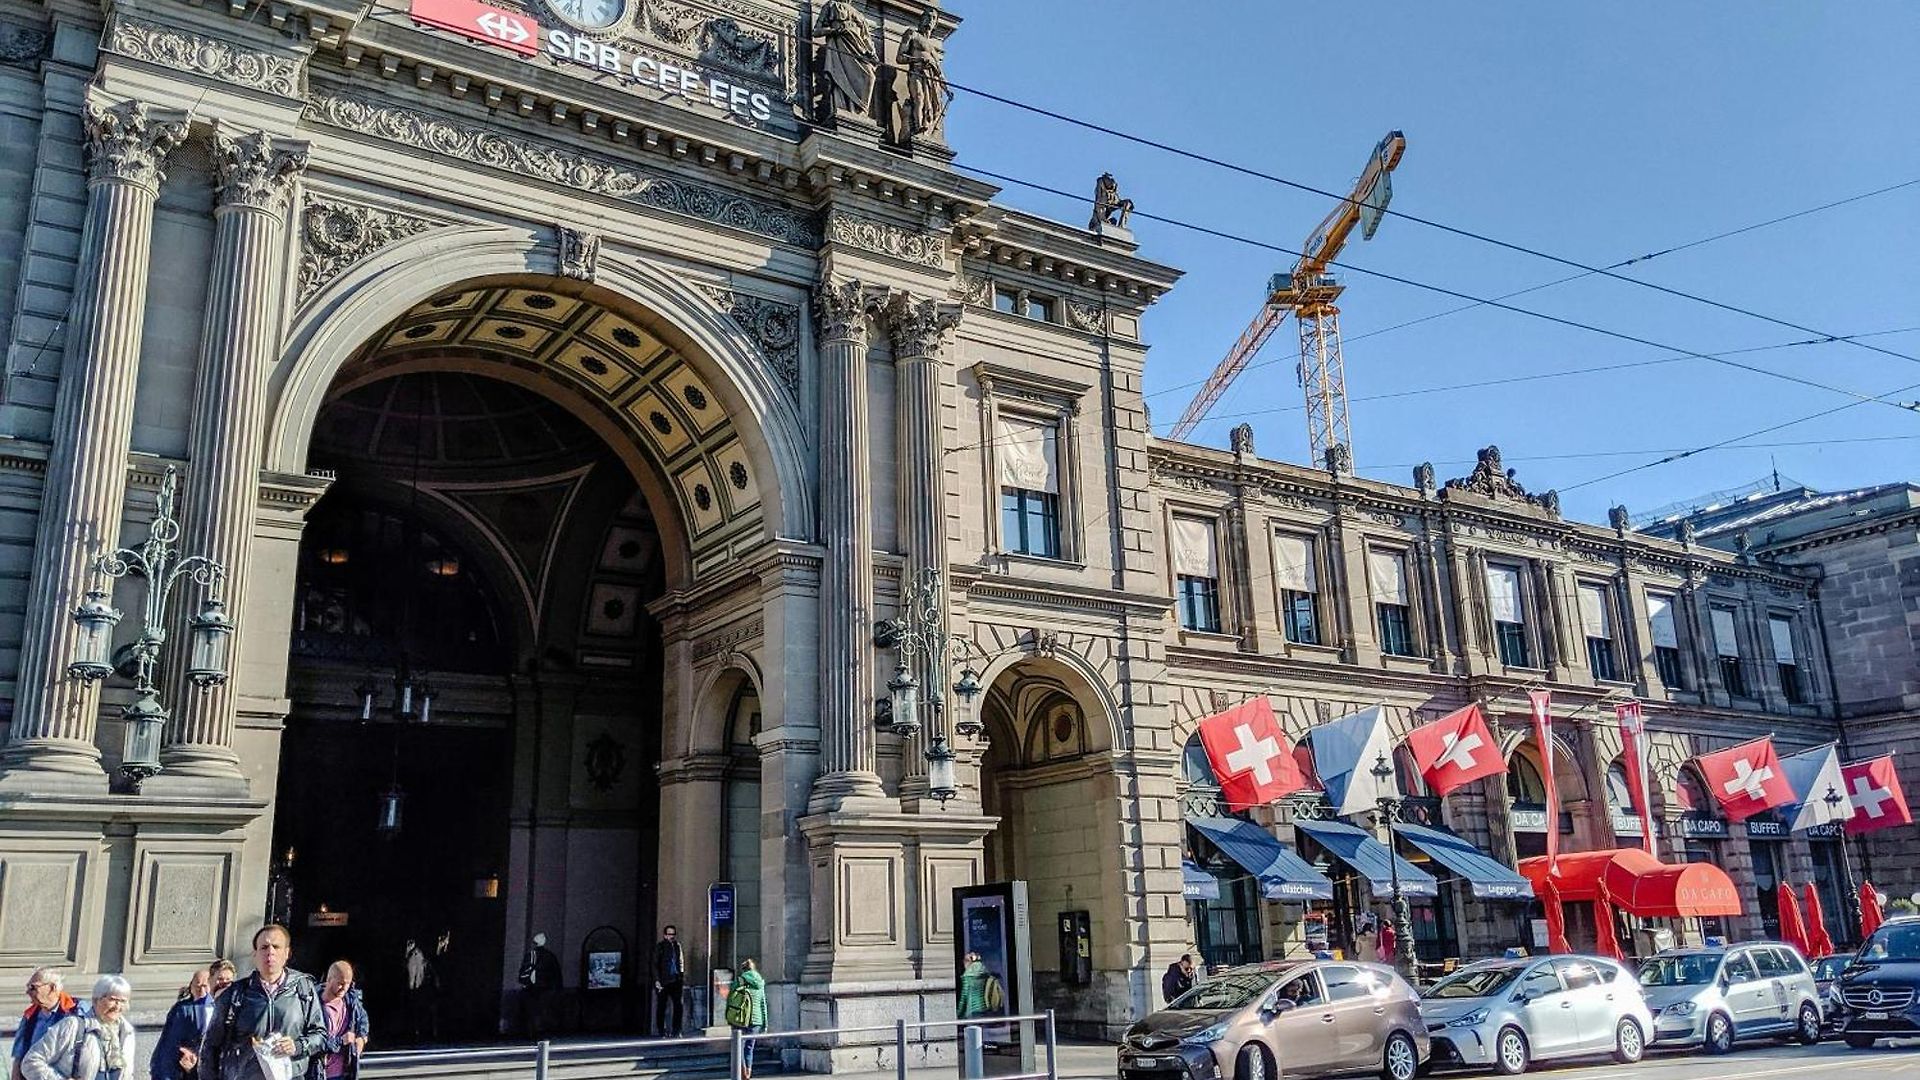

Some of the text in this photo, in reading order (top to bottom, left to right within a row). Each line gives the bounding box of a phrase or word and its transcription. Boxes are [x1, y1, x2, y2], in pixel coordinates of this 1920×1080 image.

[548, 29, 621, 73] SBB
[1514, 813, 1546, 827] DA CA
[1616, 816, 1641, 830] BUFF
[1684, 819, 1721, 833] DA CAPO
[1750, 822, 1780, 835] BUFFET
[1183, 884, 1200, 895] late
[1281, 884, 1313, 895] Watches
[1488, 884, 1517, 896] Luggages
[1681, 887, 1730, 900] DA CAPO
